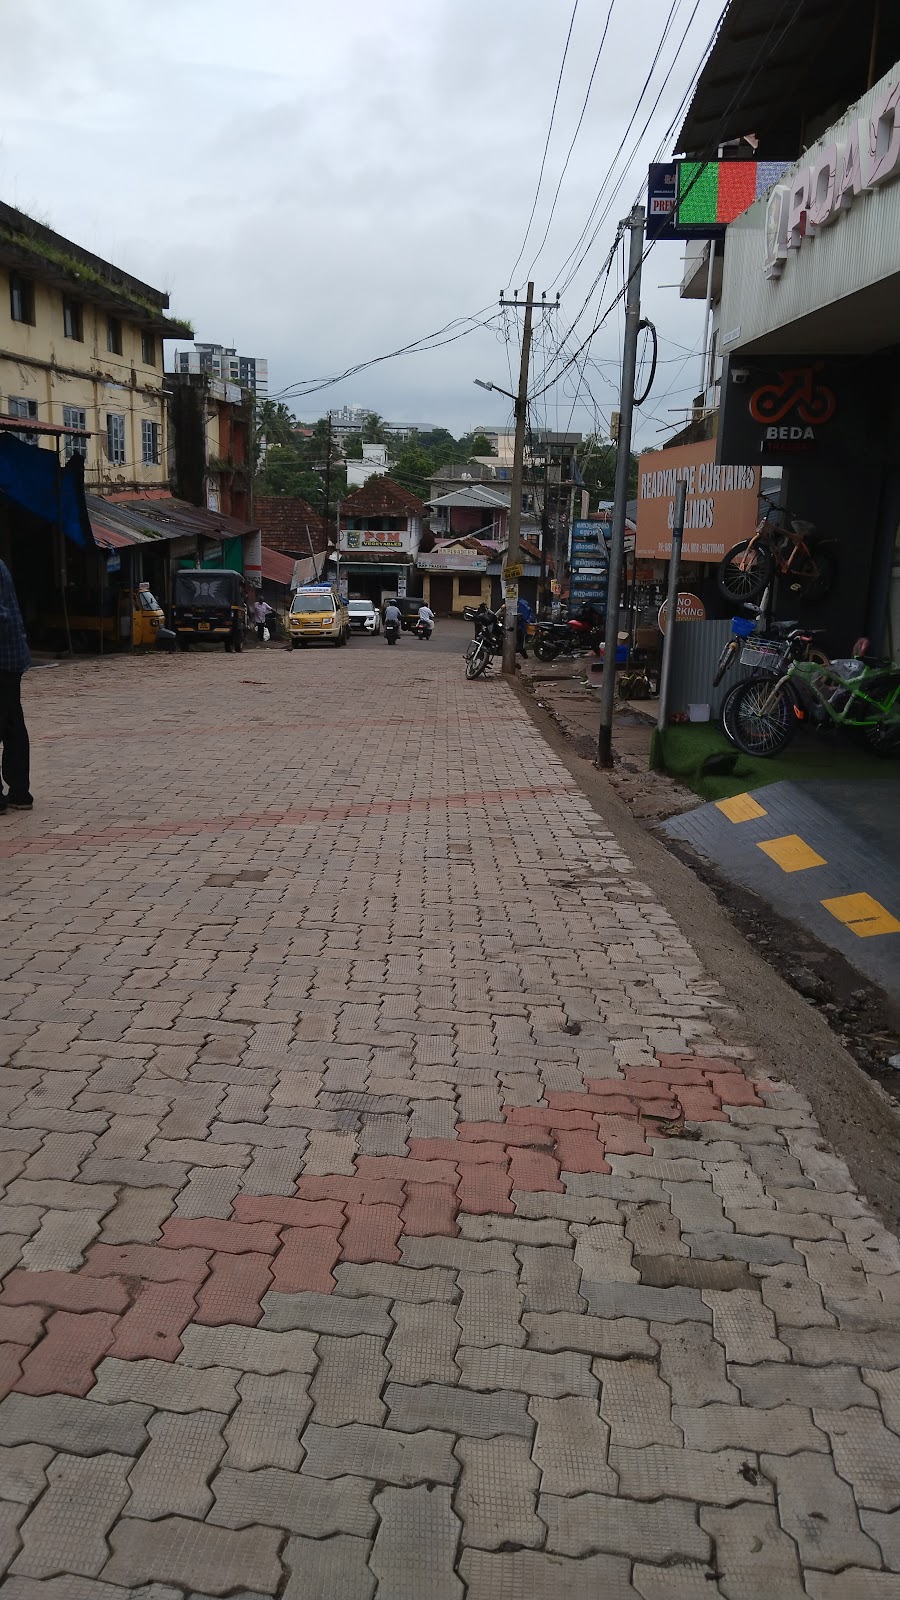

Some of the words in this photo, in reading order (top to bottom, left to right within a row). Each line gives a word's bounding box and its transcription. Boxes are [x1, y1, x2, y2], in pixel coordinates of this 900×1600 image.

[766, 427, 815, 440] BEDA
[698, 462, 755, 494] CURTAINS
[684, 498, 714, 529] LINDS
[364, 532, 400, 542] PSM
[677, 598, 692, 607] NO
[662, 606, 704, 617] PRKING
